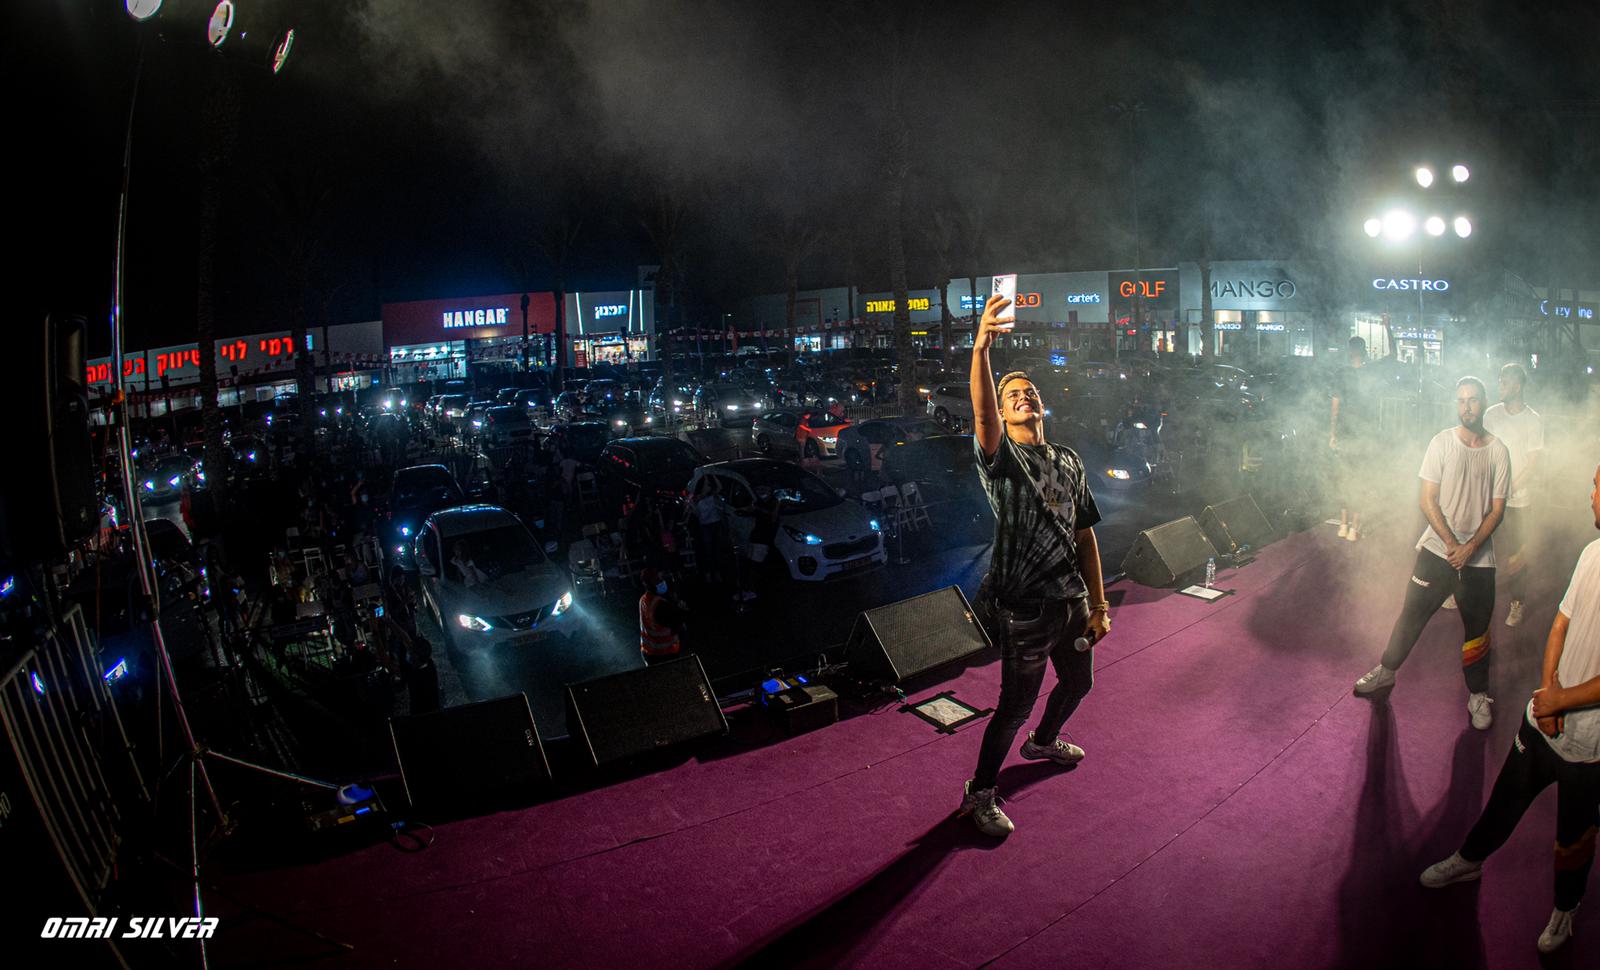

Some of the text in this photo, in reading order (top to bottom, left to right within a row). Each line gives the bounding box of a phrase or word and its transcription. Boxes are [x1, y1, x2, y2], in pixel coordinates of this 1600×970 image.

[1120, 281, 1166, 298] GOLF
[1372, 278, 1449, 291] CASTRO
[1067, 293, 1100, 303] carter's
[443, 308, 506, 328] HANGAR
[221, 339, 247, 361] לוי
[260, 336, 294, 356] רמי
